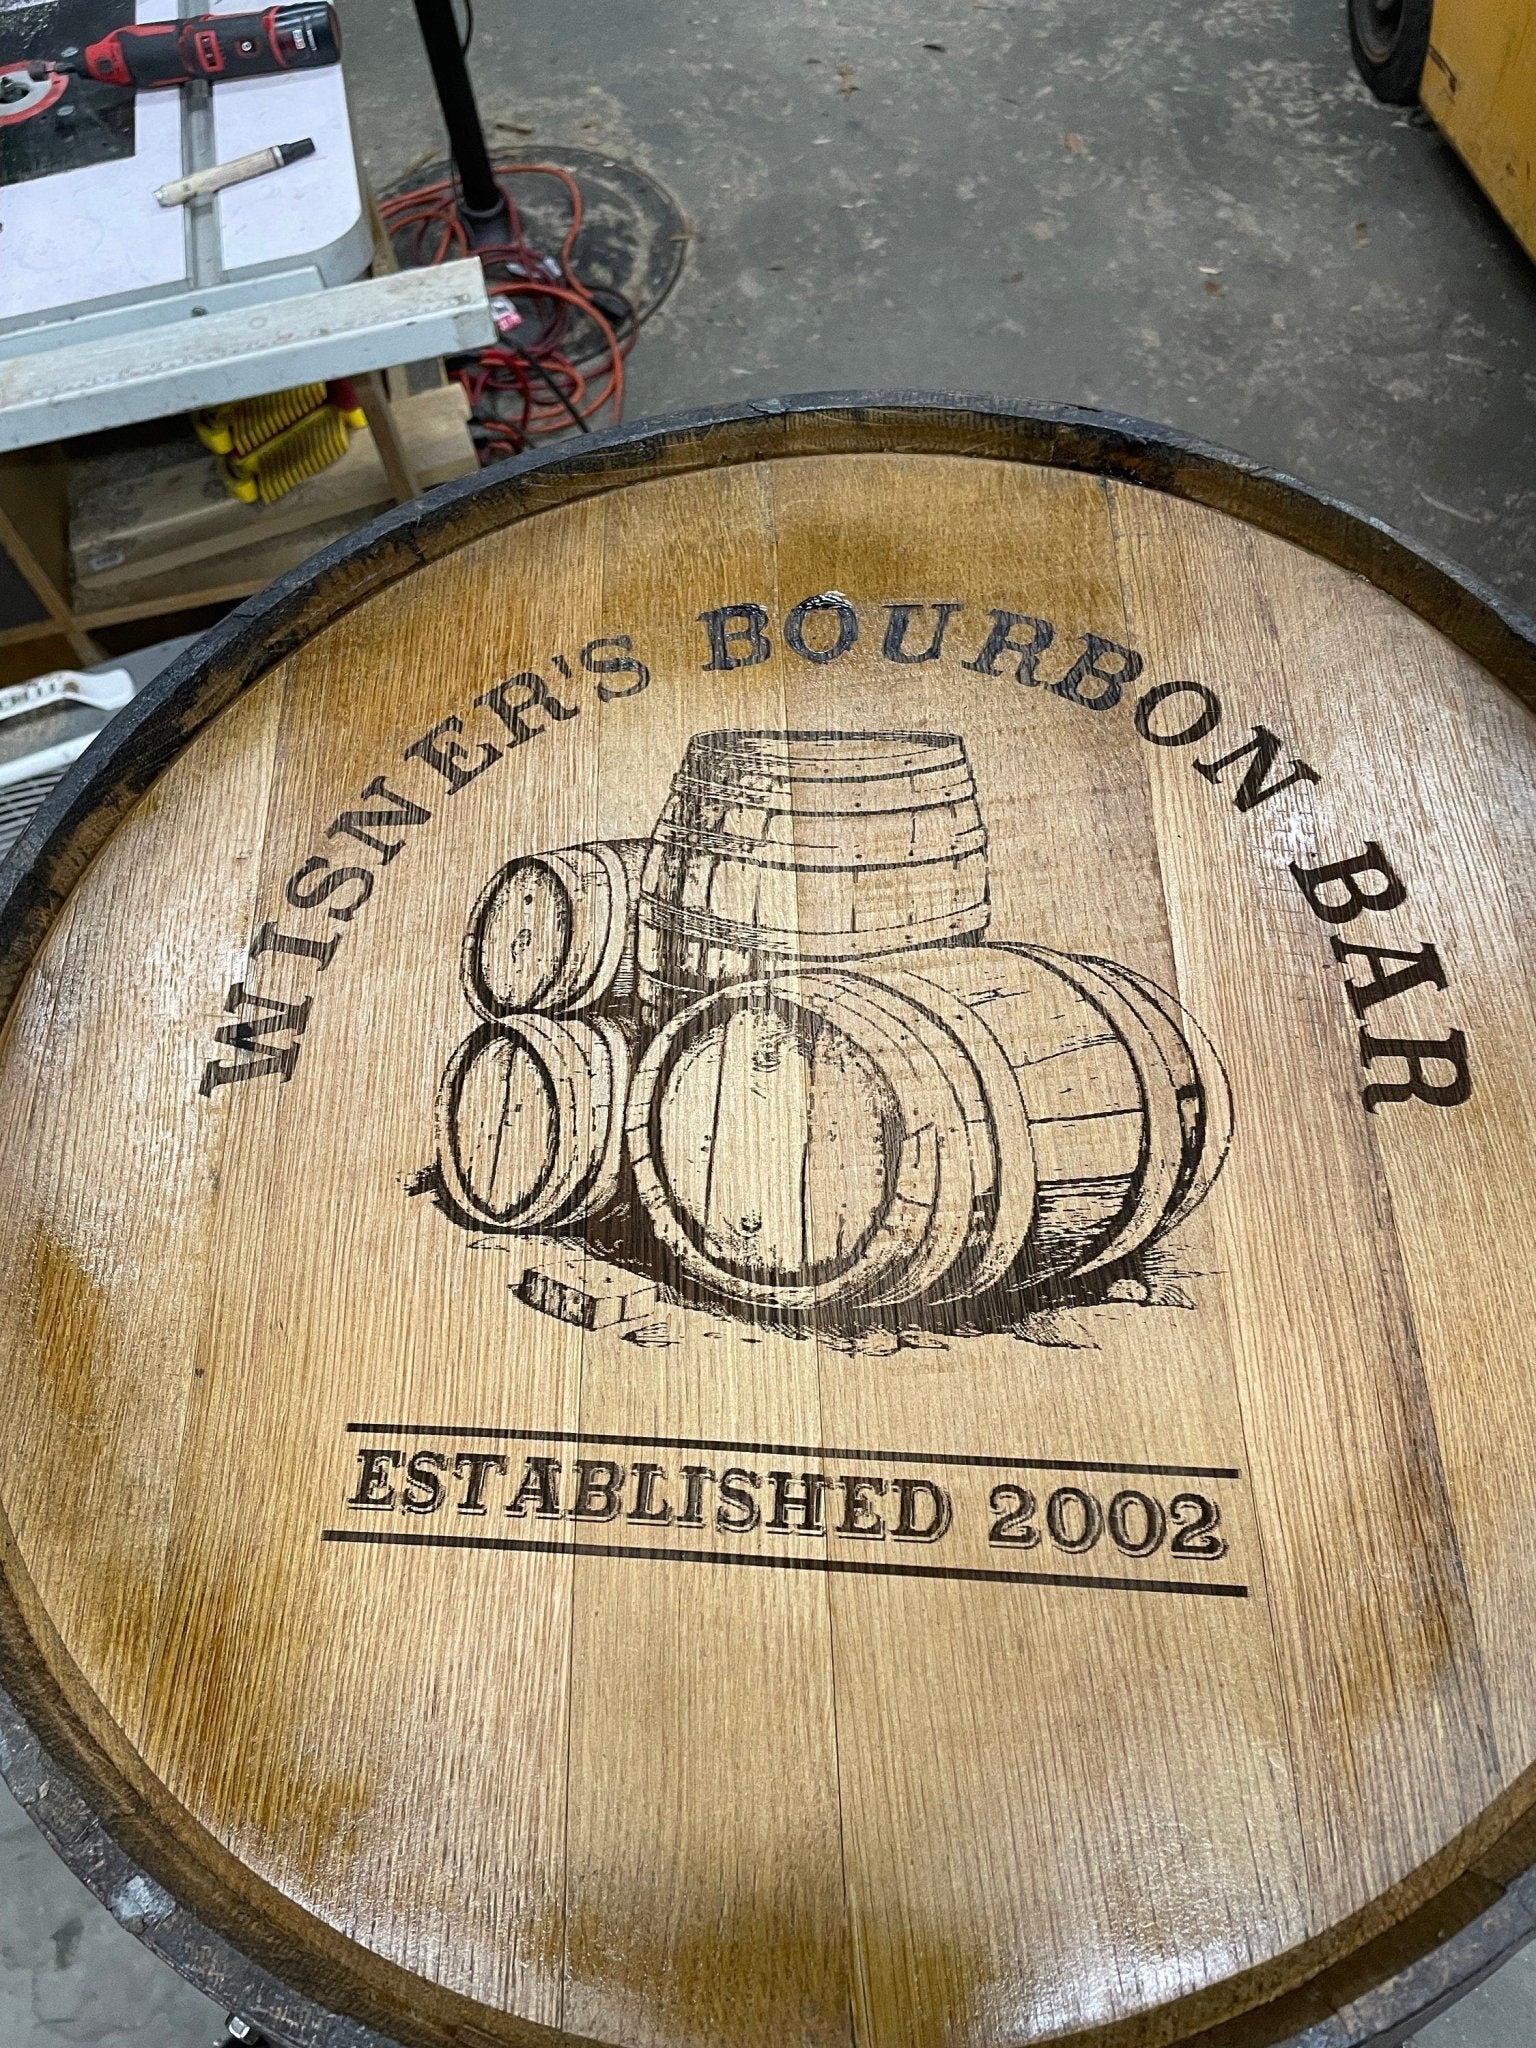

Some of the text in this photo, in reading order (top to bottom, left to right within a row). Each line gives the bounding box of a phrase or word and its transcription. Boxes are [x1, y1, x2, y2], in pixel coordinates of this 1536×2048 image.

[200, 592, 1473, 1115] WISNER'S BOURBON BAR
[347, 1448, 1229, 1560] ESTABLISHED 2002
